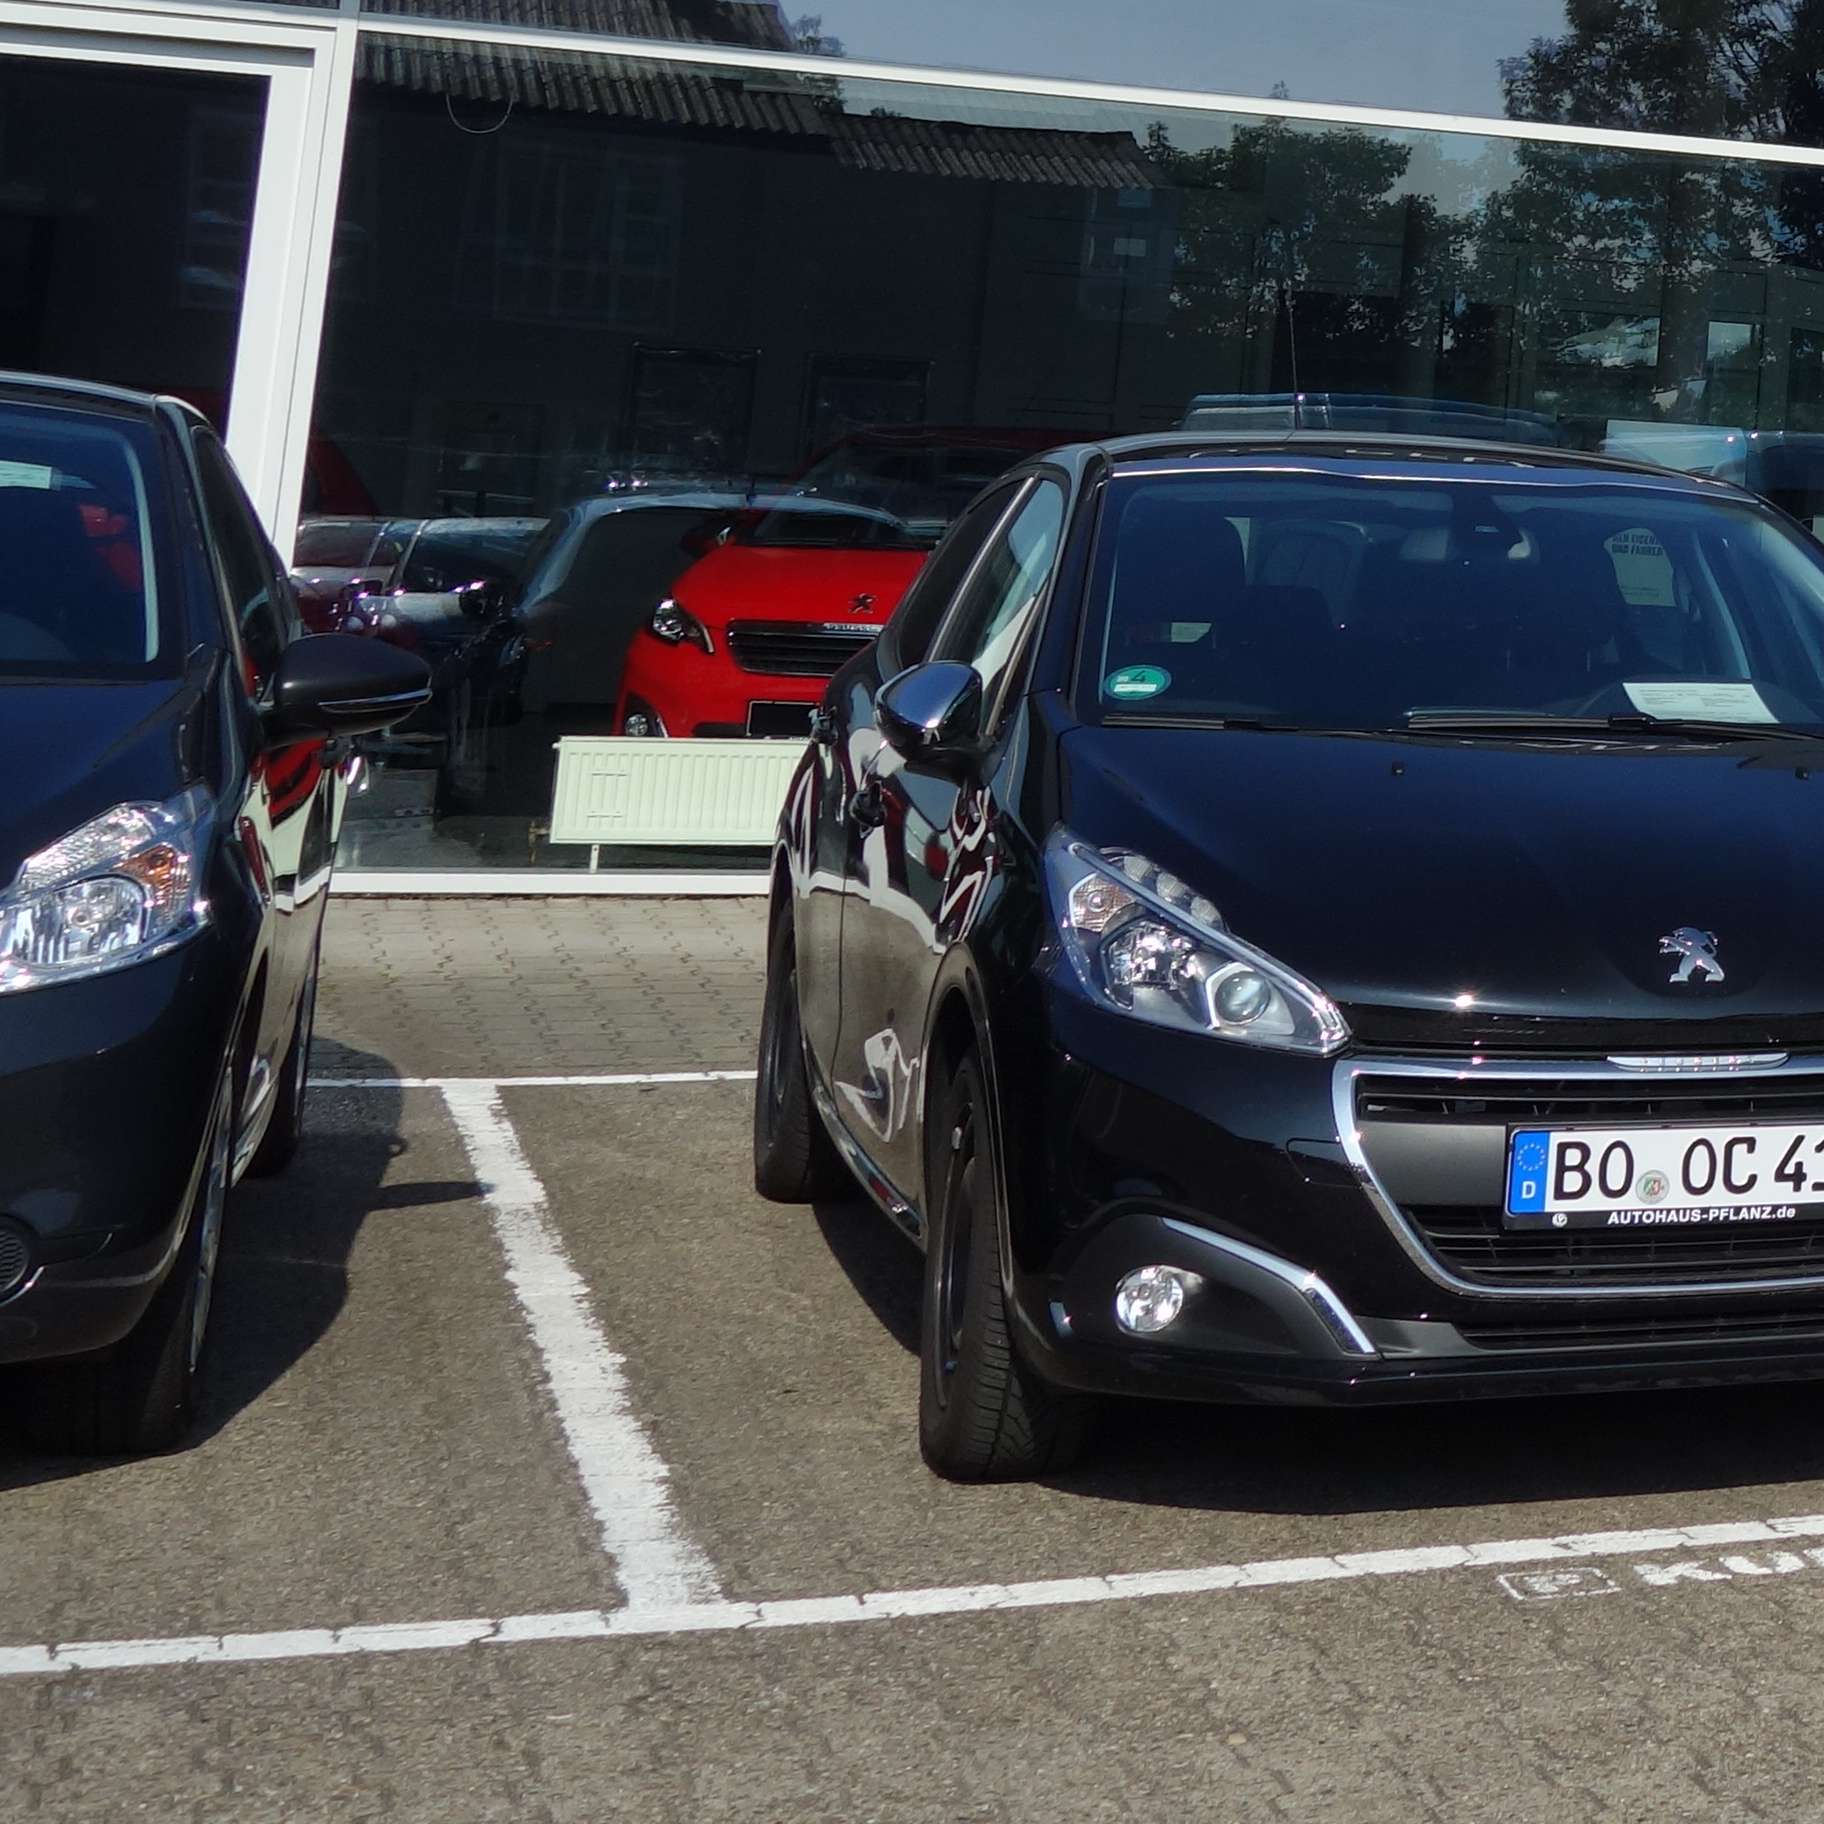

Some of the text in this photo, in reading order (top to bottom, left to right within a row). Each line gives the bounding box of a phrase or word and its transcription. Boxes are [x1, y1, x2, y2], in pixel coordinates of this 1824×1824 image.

[1552, 1138, 1636, 1202] BO
[1681, 1135, 1759, 1197] OC
[1520, 1180, 1537, 1200] D
[1607, 1205, 1797, 1226] AUTOHAUS-PFLANZ.de
